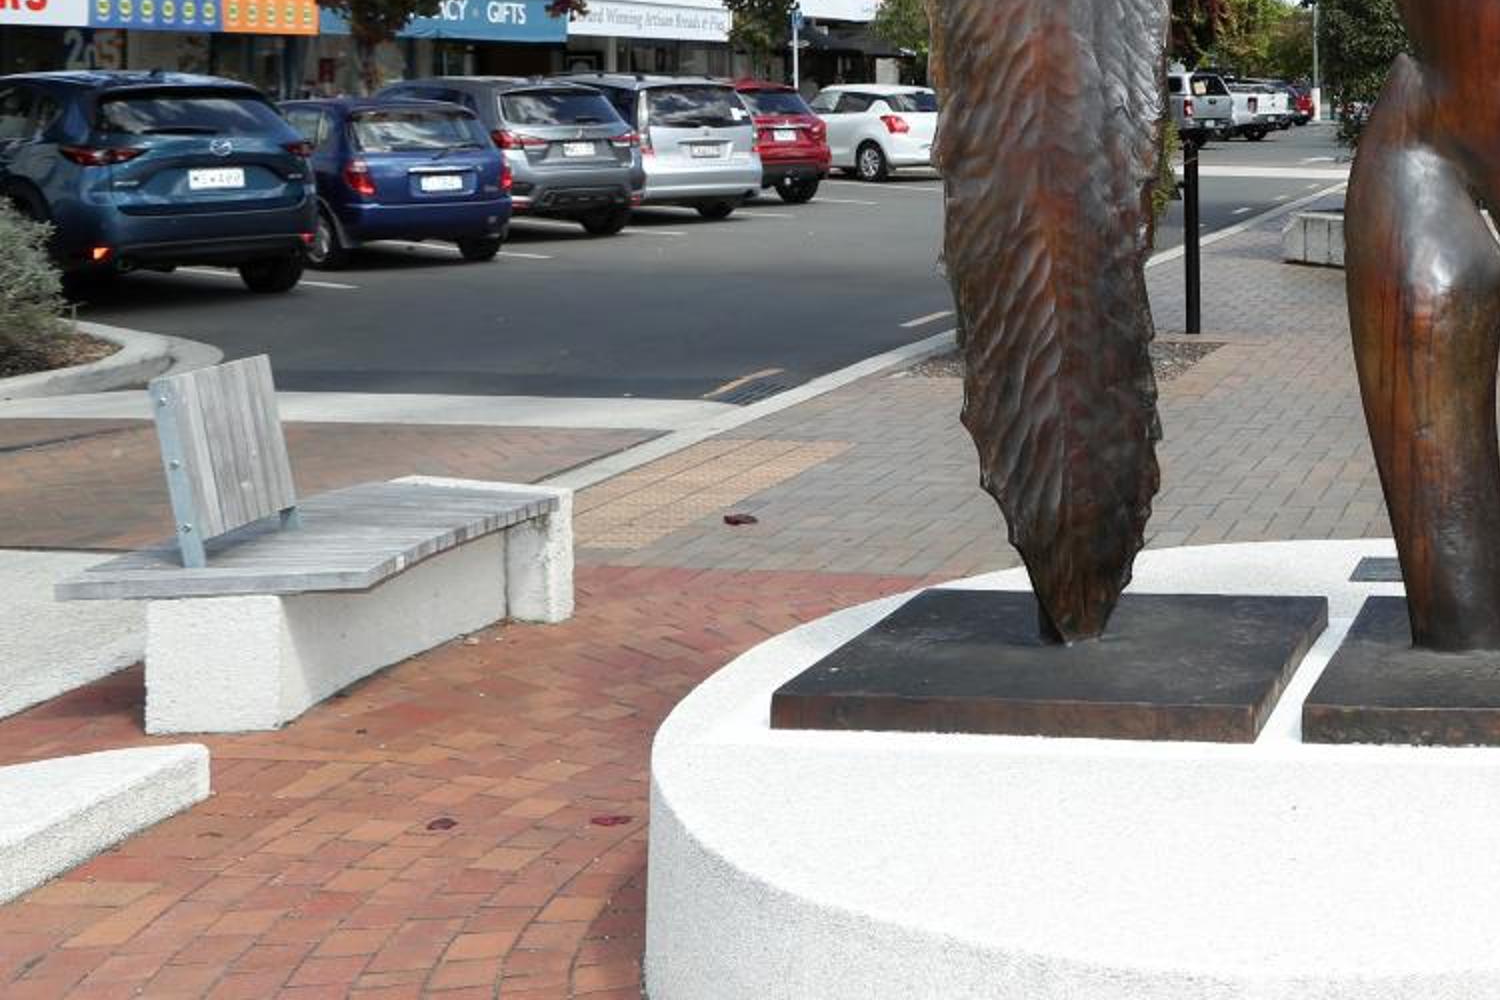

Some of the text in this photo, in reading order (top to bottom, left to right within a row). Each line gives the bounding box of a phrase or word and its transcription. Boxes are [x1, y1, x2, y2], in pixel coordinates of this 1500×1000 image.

[487, 0, 526, 25] GIFTS
[605, 7, 642, 30] Winning
[644, 11, 673, 27] Artisan
